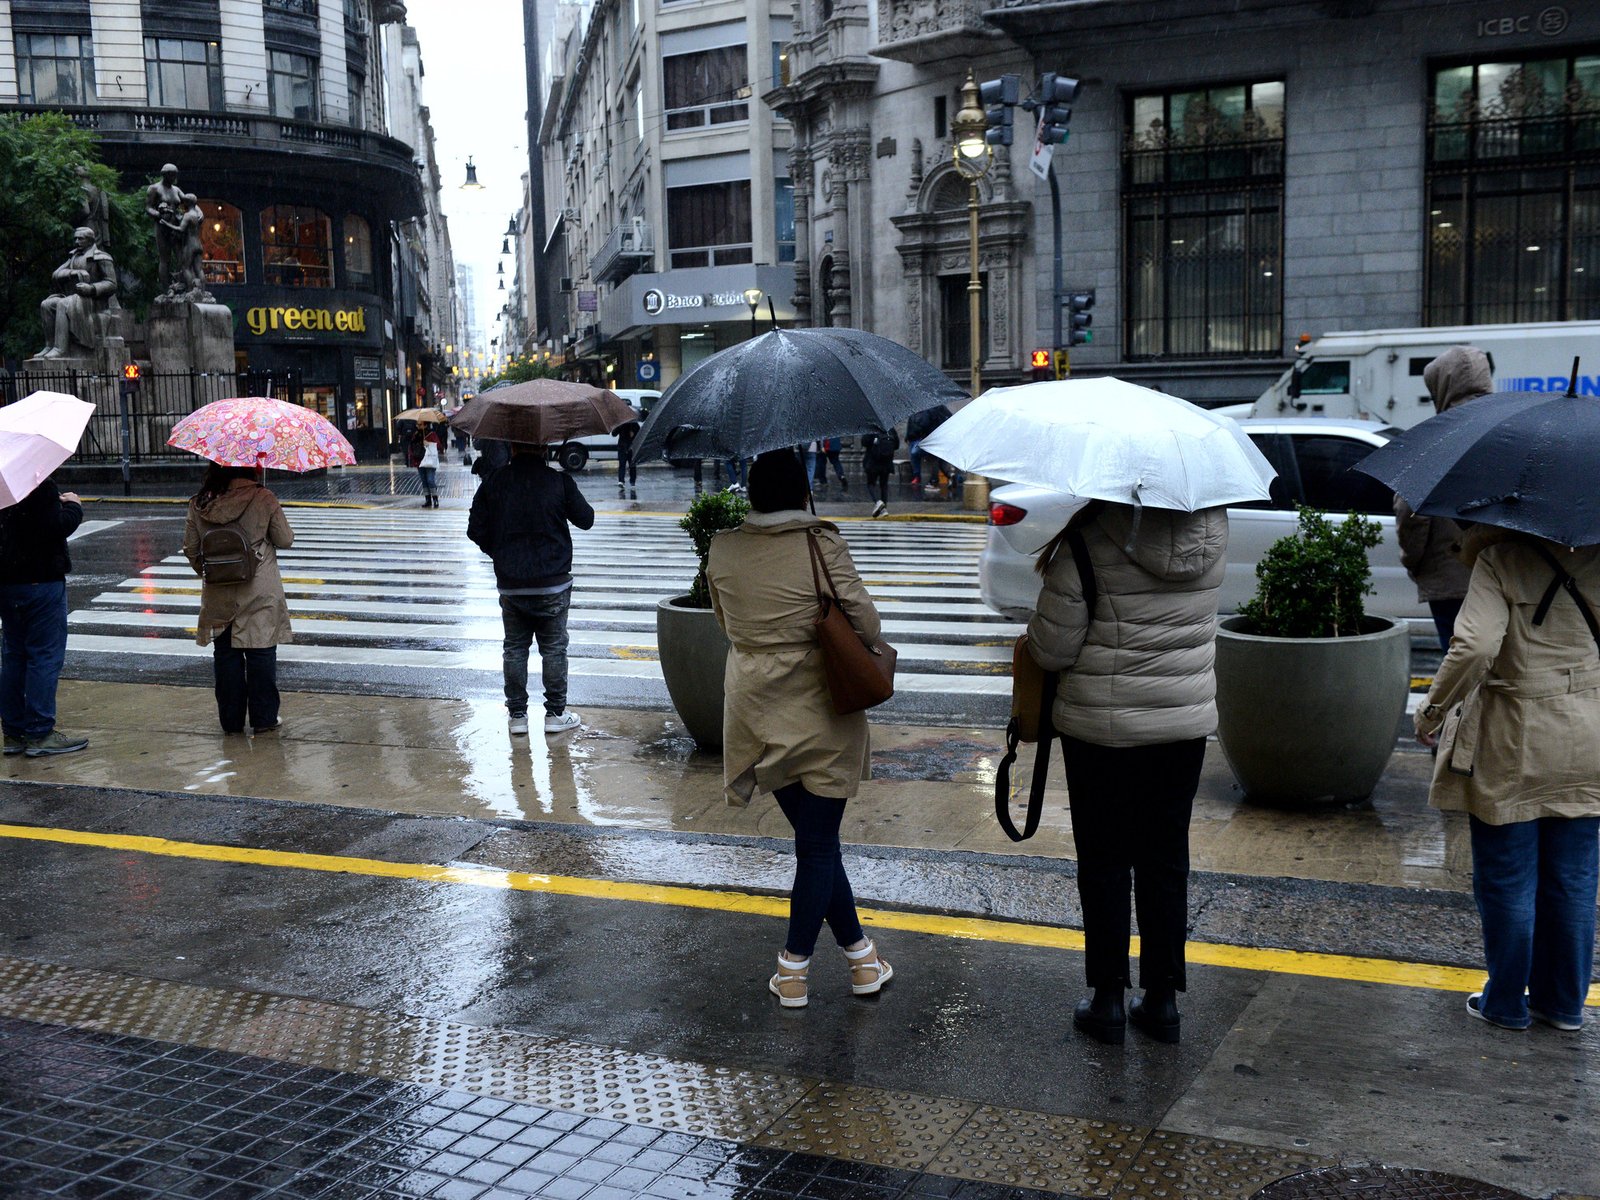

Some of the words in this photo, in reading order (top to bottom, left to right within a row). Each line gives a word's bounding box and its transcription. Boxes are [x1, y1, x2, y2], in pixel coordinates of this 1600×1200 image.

[1477, 16, 1530, 37] ICBC
[666, 294, 702, 310] Banco
[246, 306, 334, 336] green
[335, 306, 366, 333] eat
